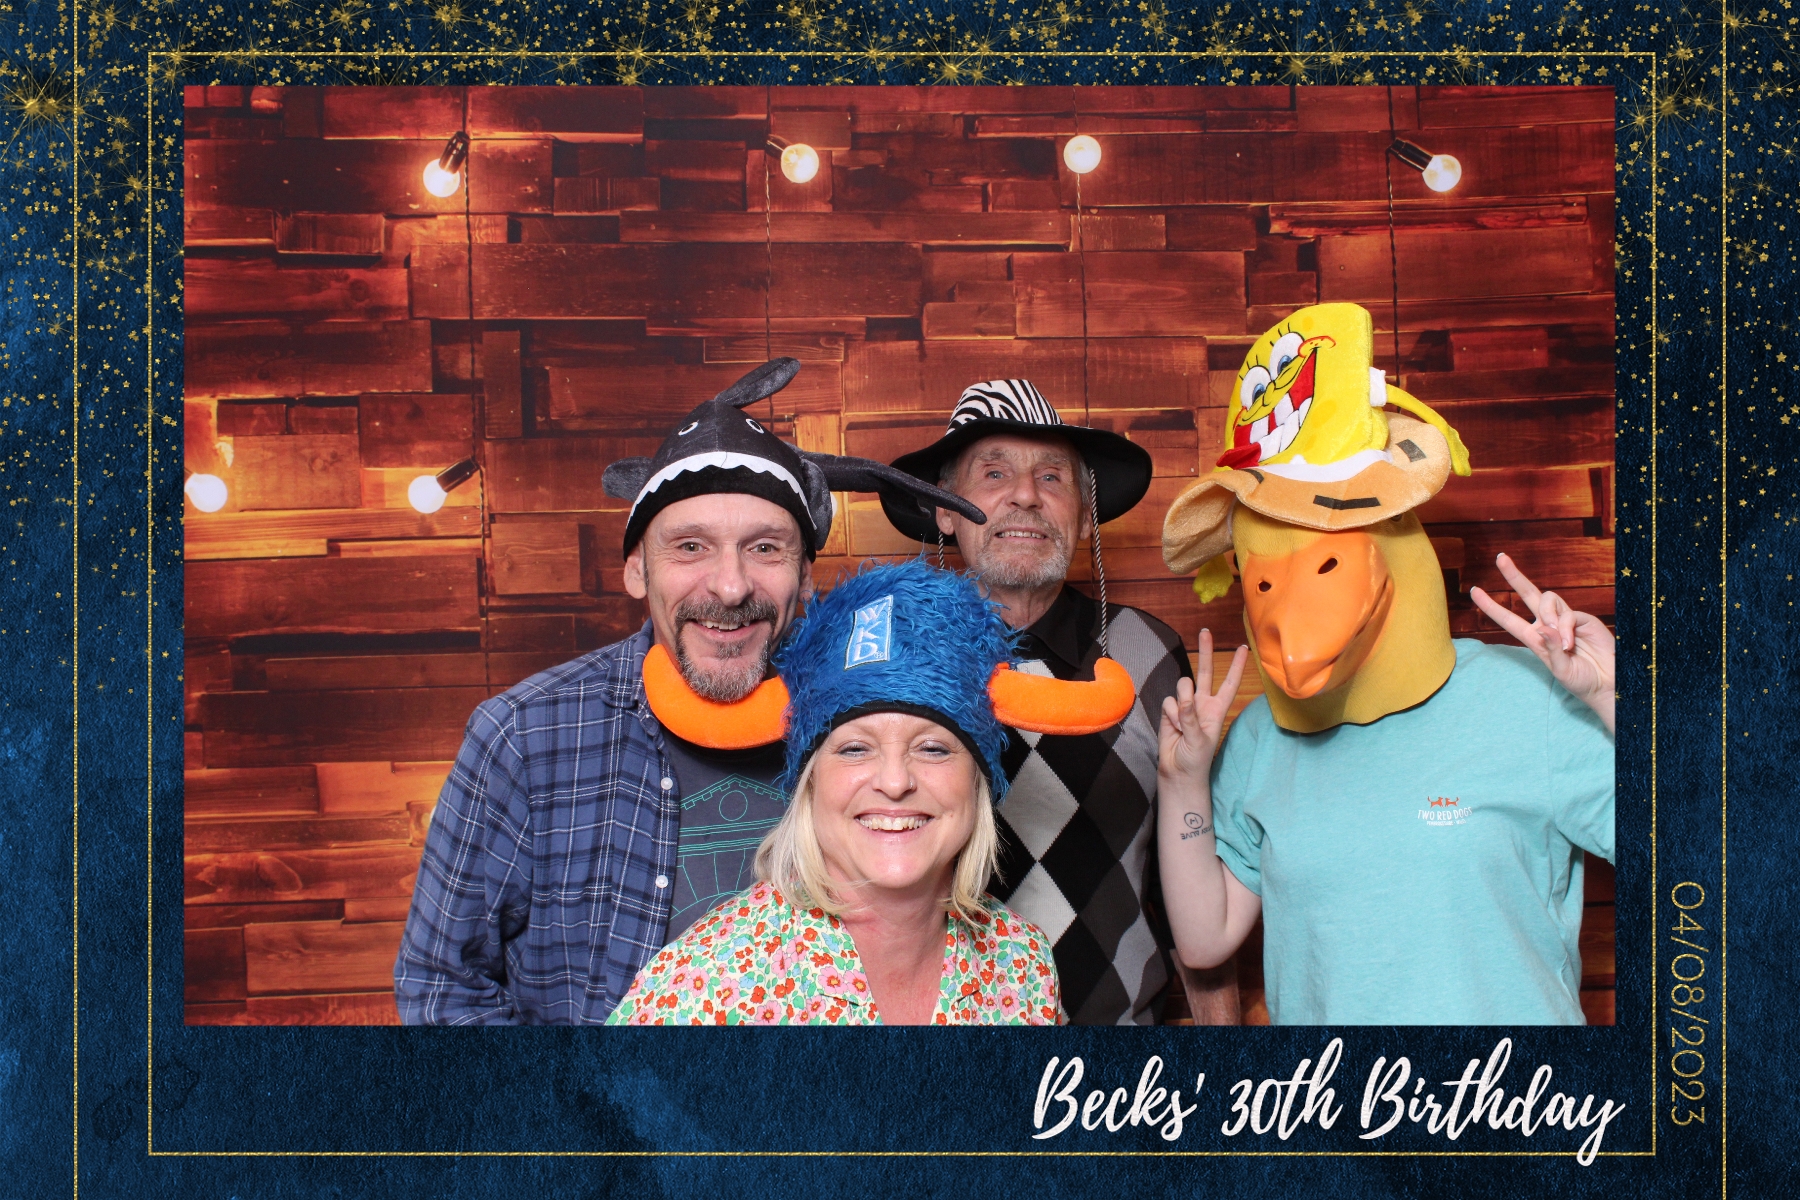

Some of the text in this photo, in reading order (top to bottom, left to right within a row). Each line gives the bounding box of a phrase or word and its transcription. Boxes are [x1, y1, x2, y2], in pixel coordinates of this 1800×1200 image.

[1417, 806, 1473, 821] TWO RED DOGS
